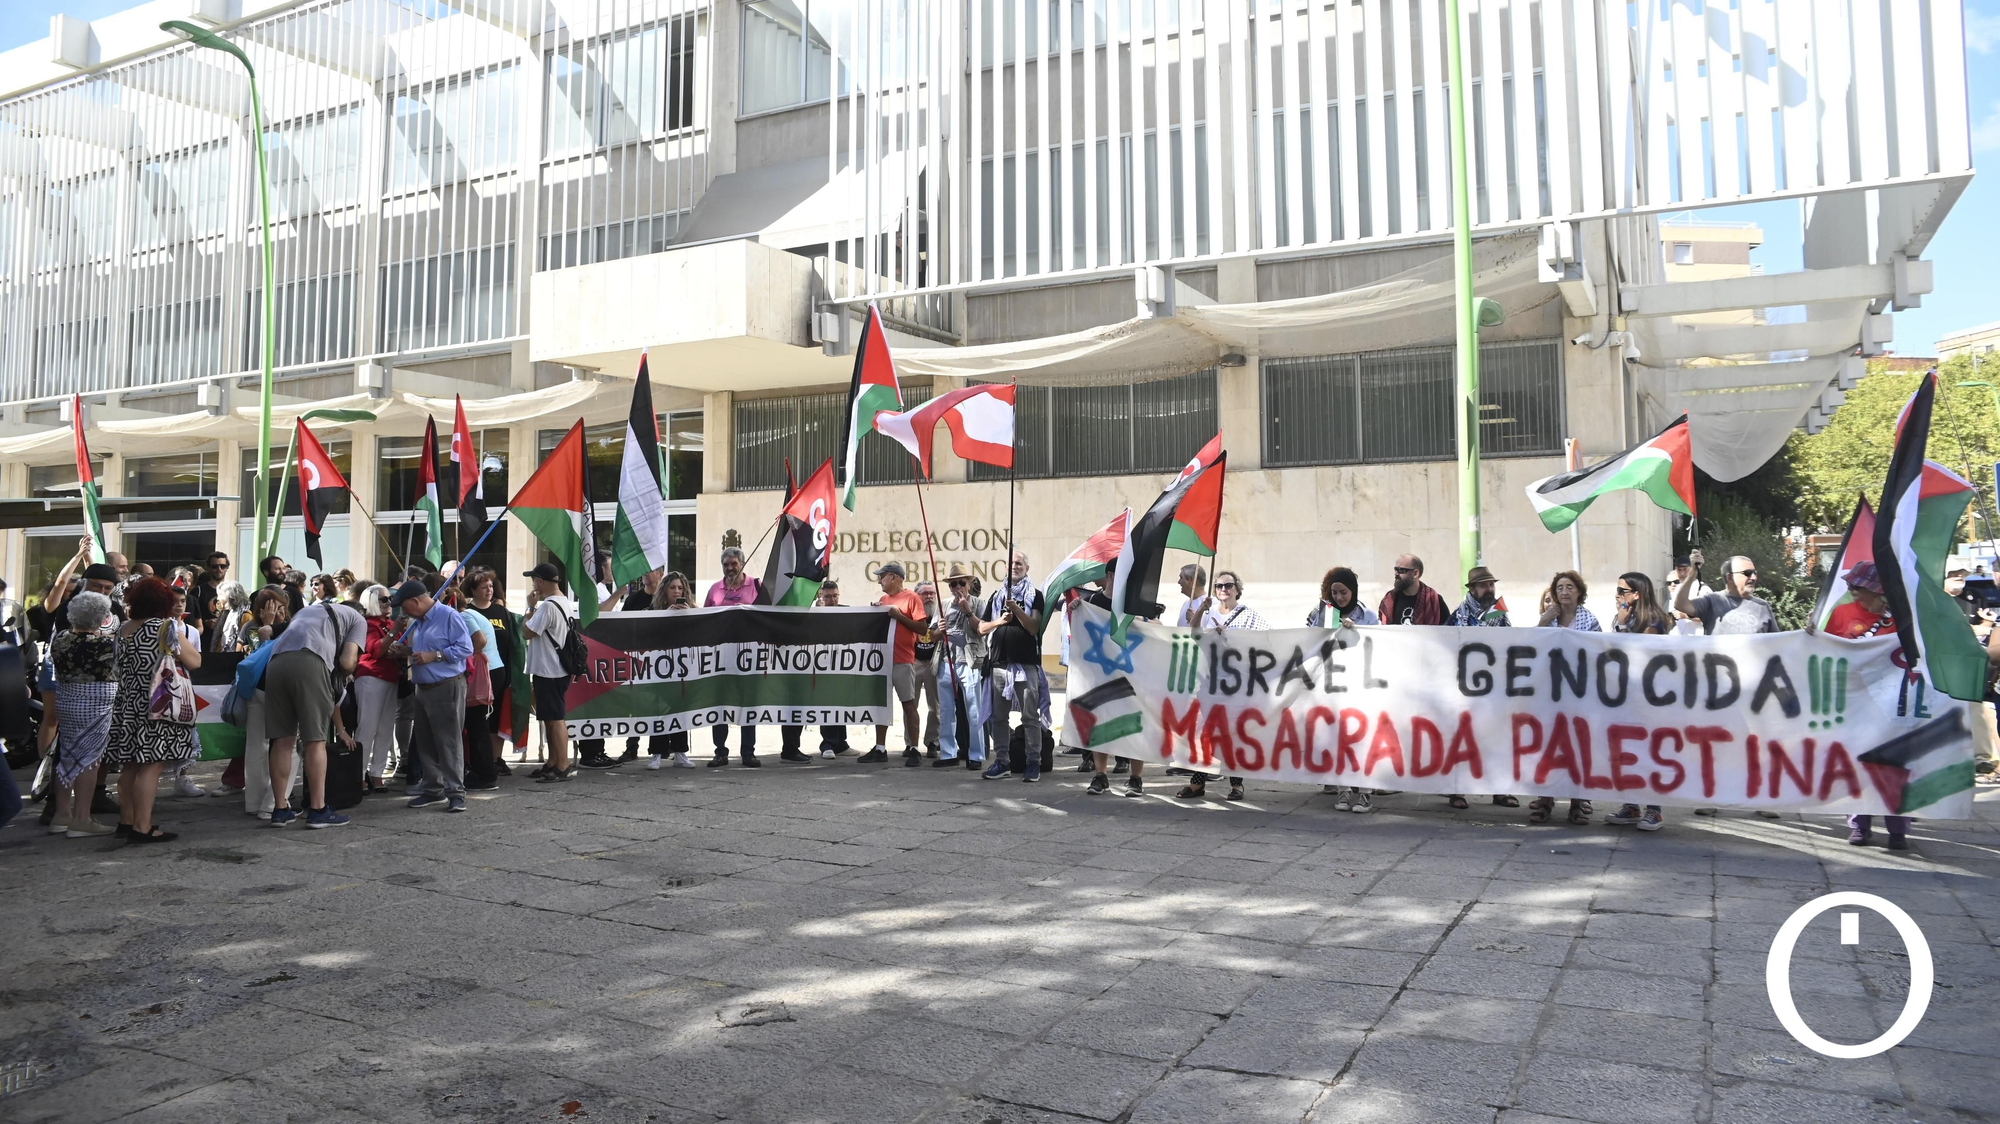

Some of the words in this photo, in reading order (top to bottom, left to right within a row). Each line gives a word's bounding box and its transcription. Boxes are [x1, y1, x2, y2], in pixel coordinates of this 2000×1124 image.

[830, 528, 1009, 553] BDELEGACION
[572, 654, 689, 684] AREMOS
[700, 651, 726, 675] EL
[736, 649, 884, 672] GENOCIDIO
[567, 717, 682, 739] CÓRDOBA
[692, 710, 735, 727] CON
[746, 710, 874, 724] PALESTINA
[1160, 697, 1483, 779] MASACRADA
[1511, 711, 1862, 801] PALESTINA
